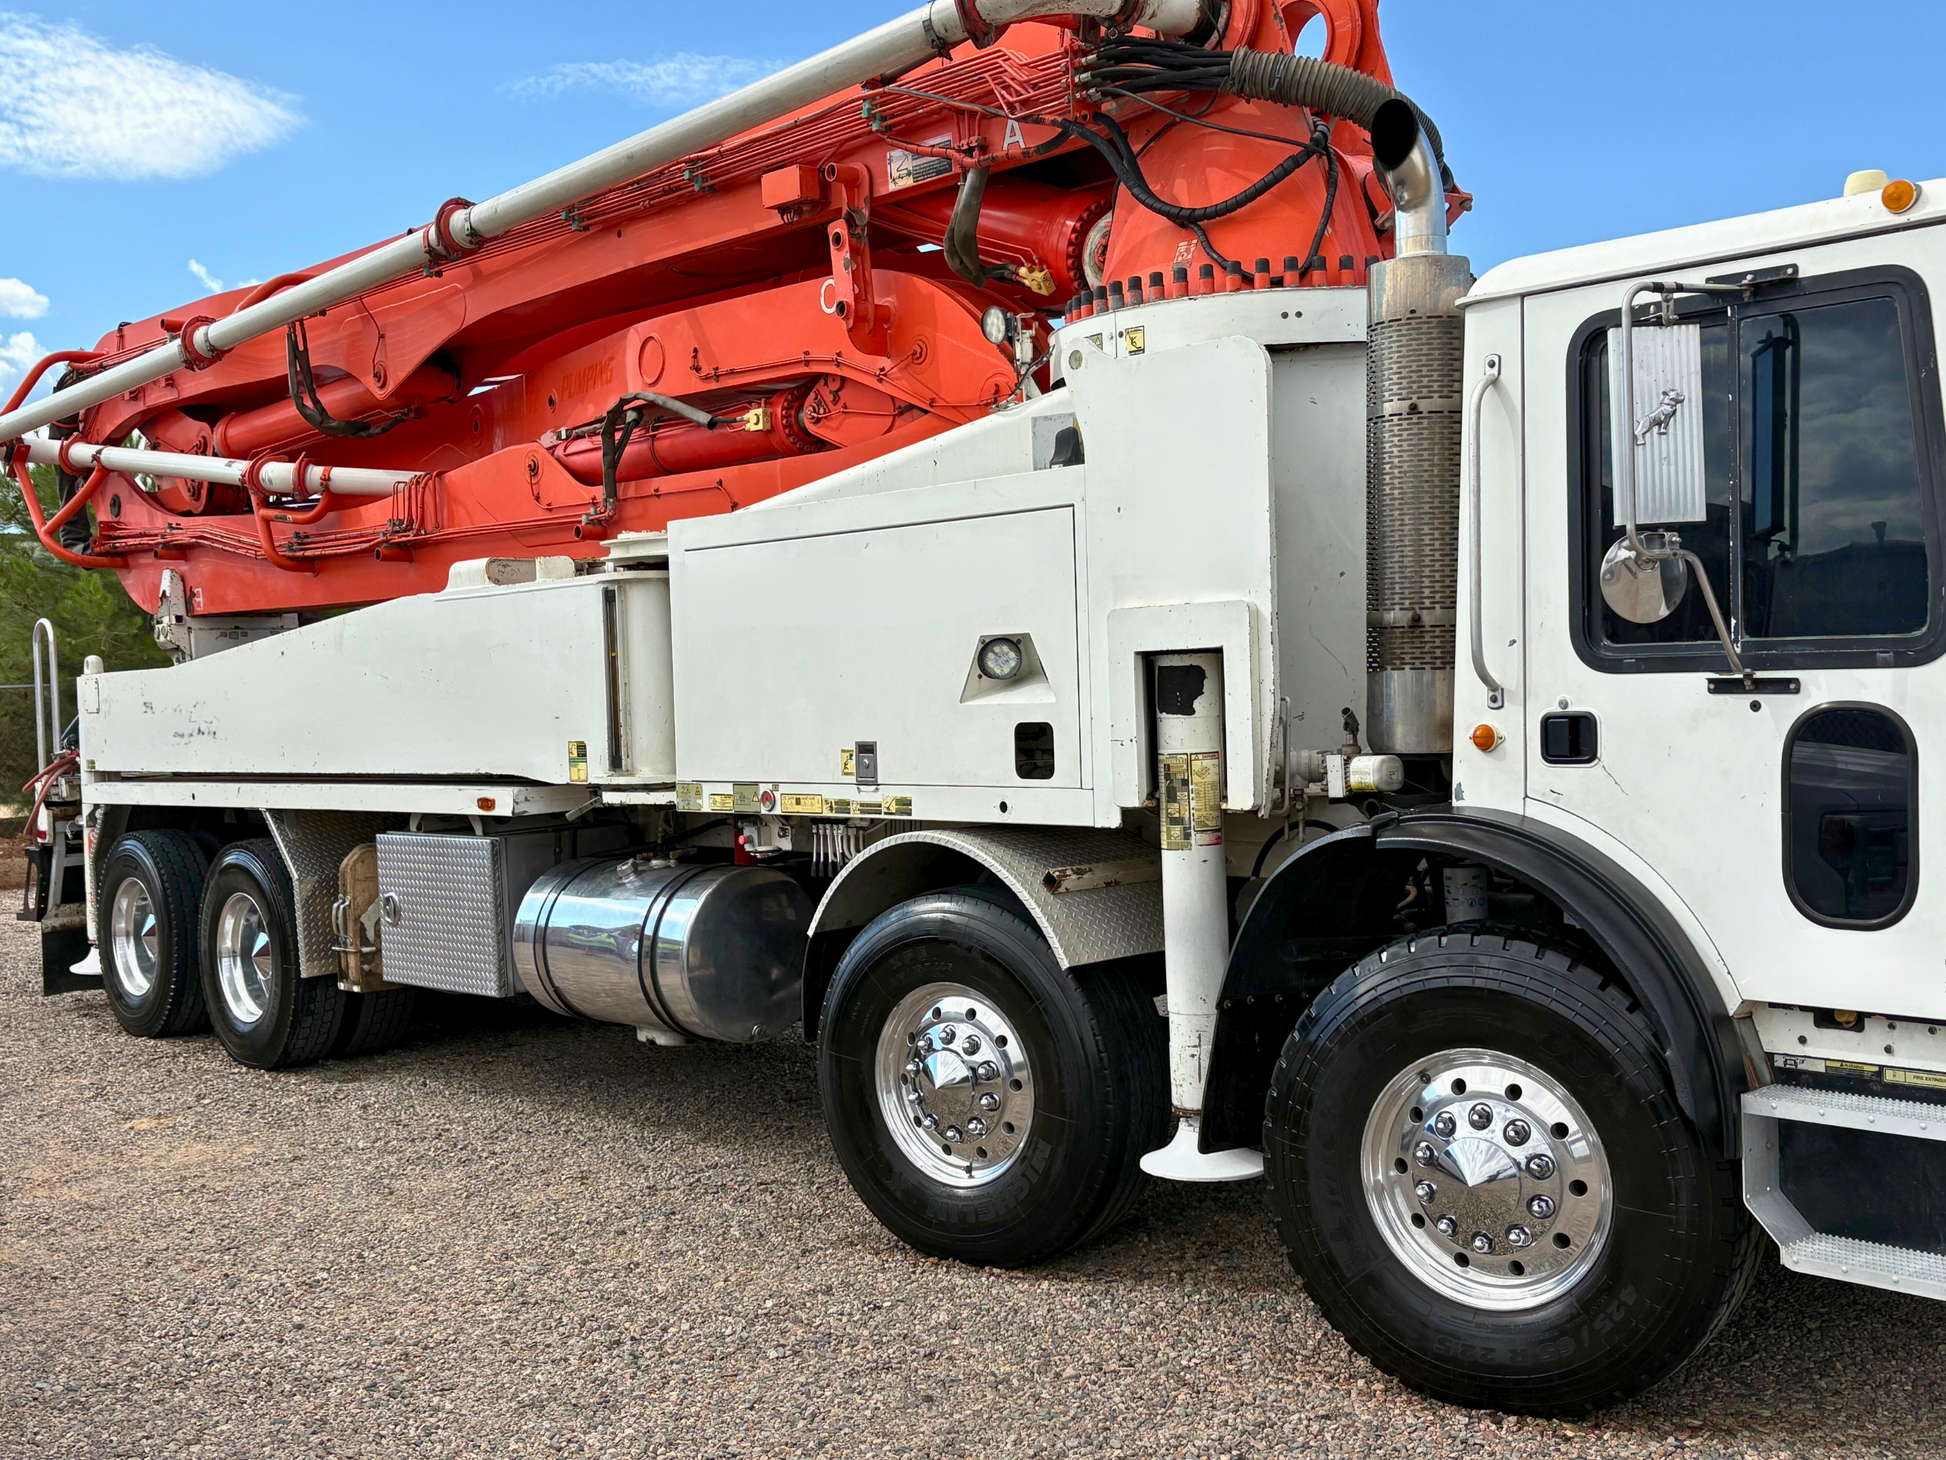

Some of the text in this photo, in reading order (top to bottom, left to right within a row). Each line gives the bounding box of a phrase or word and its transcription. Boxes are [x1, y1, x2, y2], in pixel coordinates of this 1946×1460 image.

[1002, 118, 1026, 151] A
[560, 356, 615, 402] PUMPING
[926, 1137, 1052, 1223] MICHELIN
